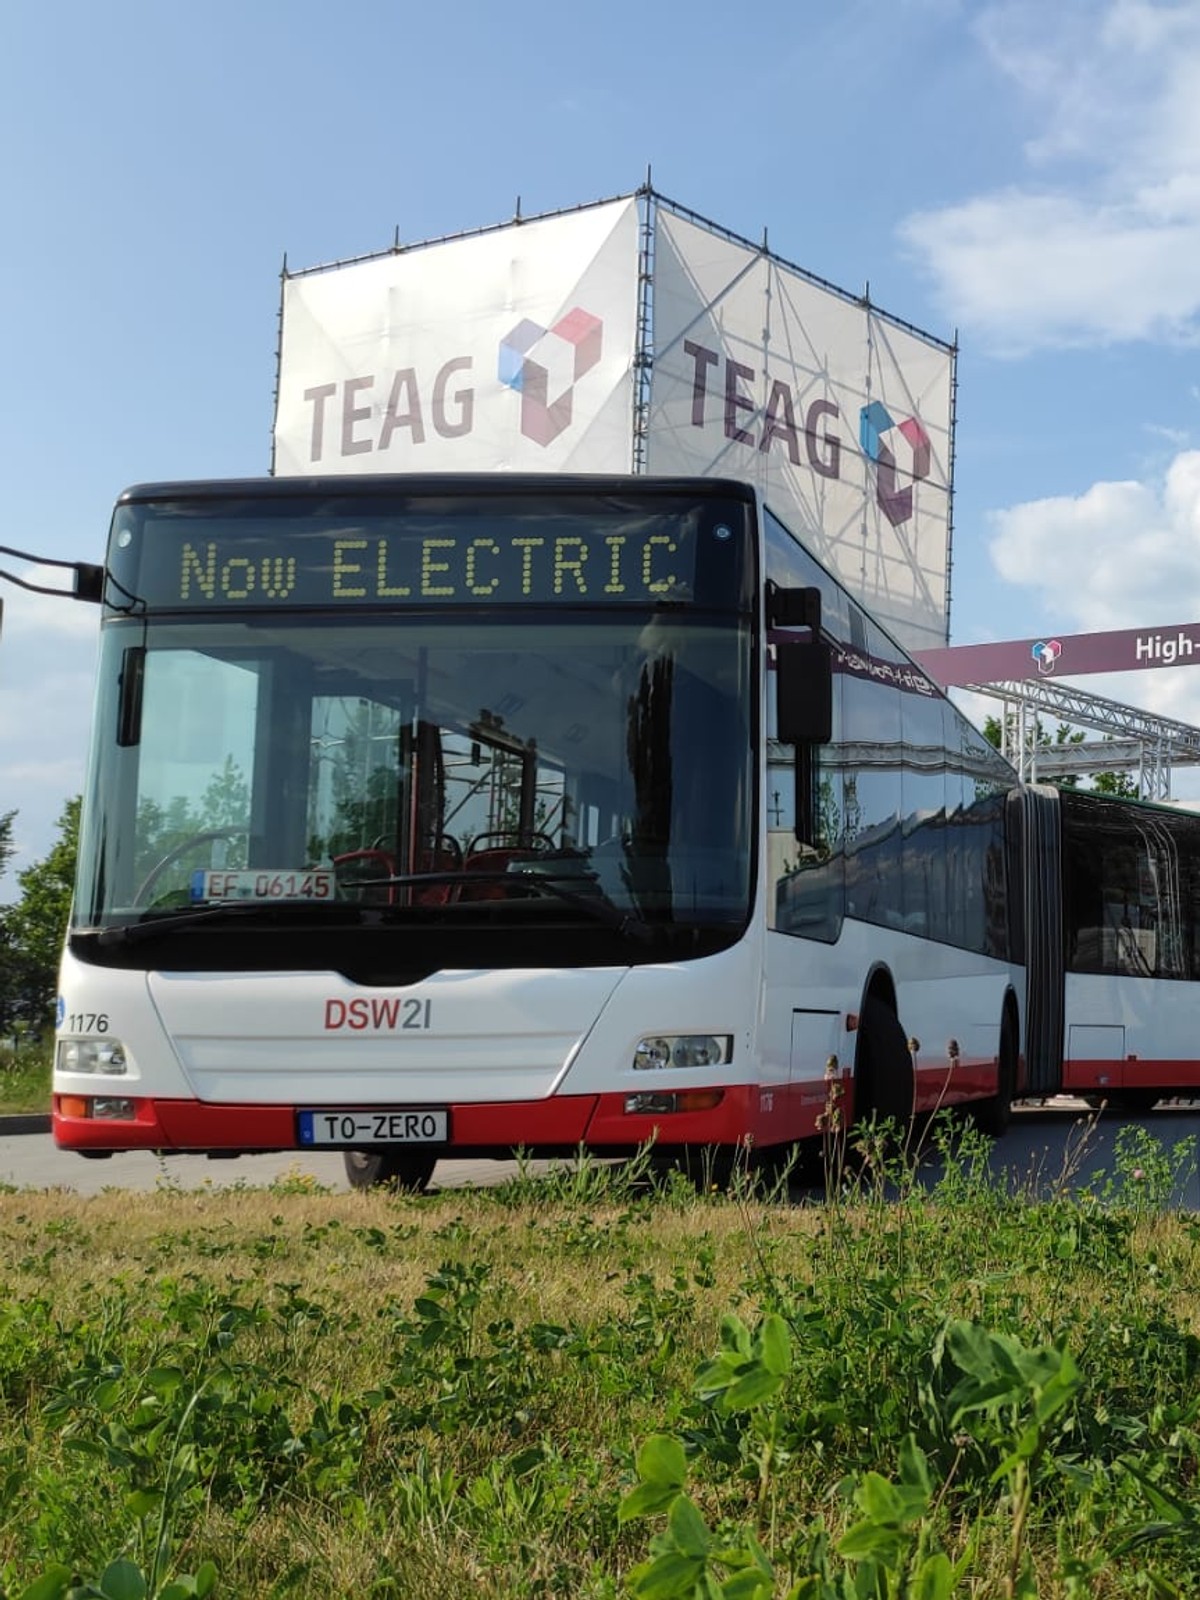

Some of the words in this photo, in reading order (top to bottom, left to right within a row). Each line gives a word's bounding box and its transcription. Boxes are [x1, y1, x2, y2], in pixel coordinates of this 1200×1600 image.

[303, 355, 475, 462] TEAG
[683, 338, 841, 480] TEAG
[333, 535, 677, 597] ELECTRIC
[208, 874, 239, 897] EF
[255, 874, 330, 898] 06145
[69, 1013, 109, 1033] 1176
[324, 1114, 437, 1140] TO-ZERO
